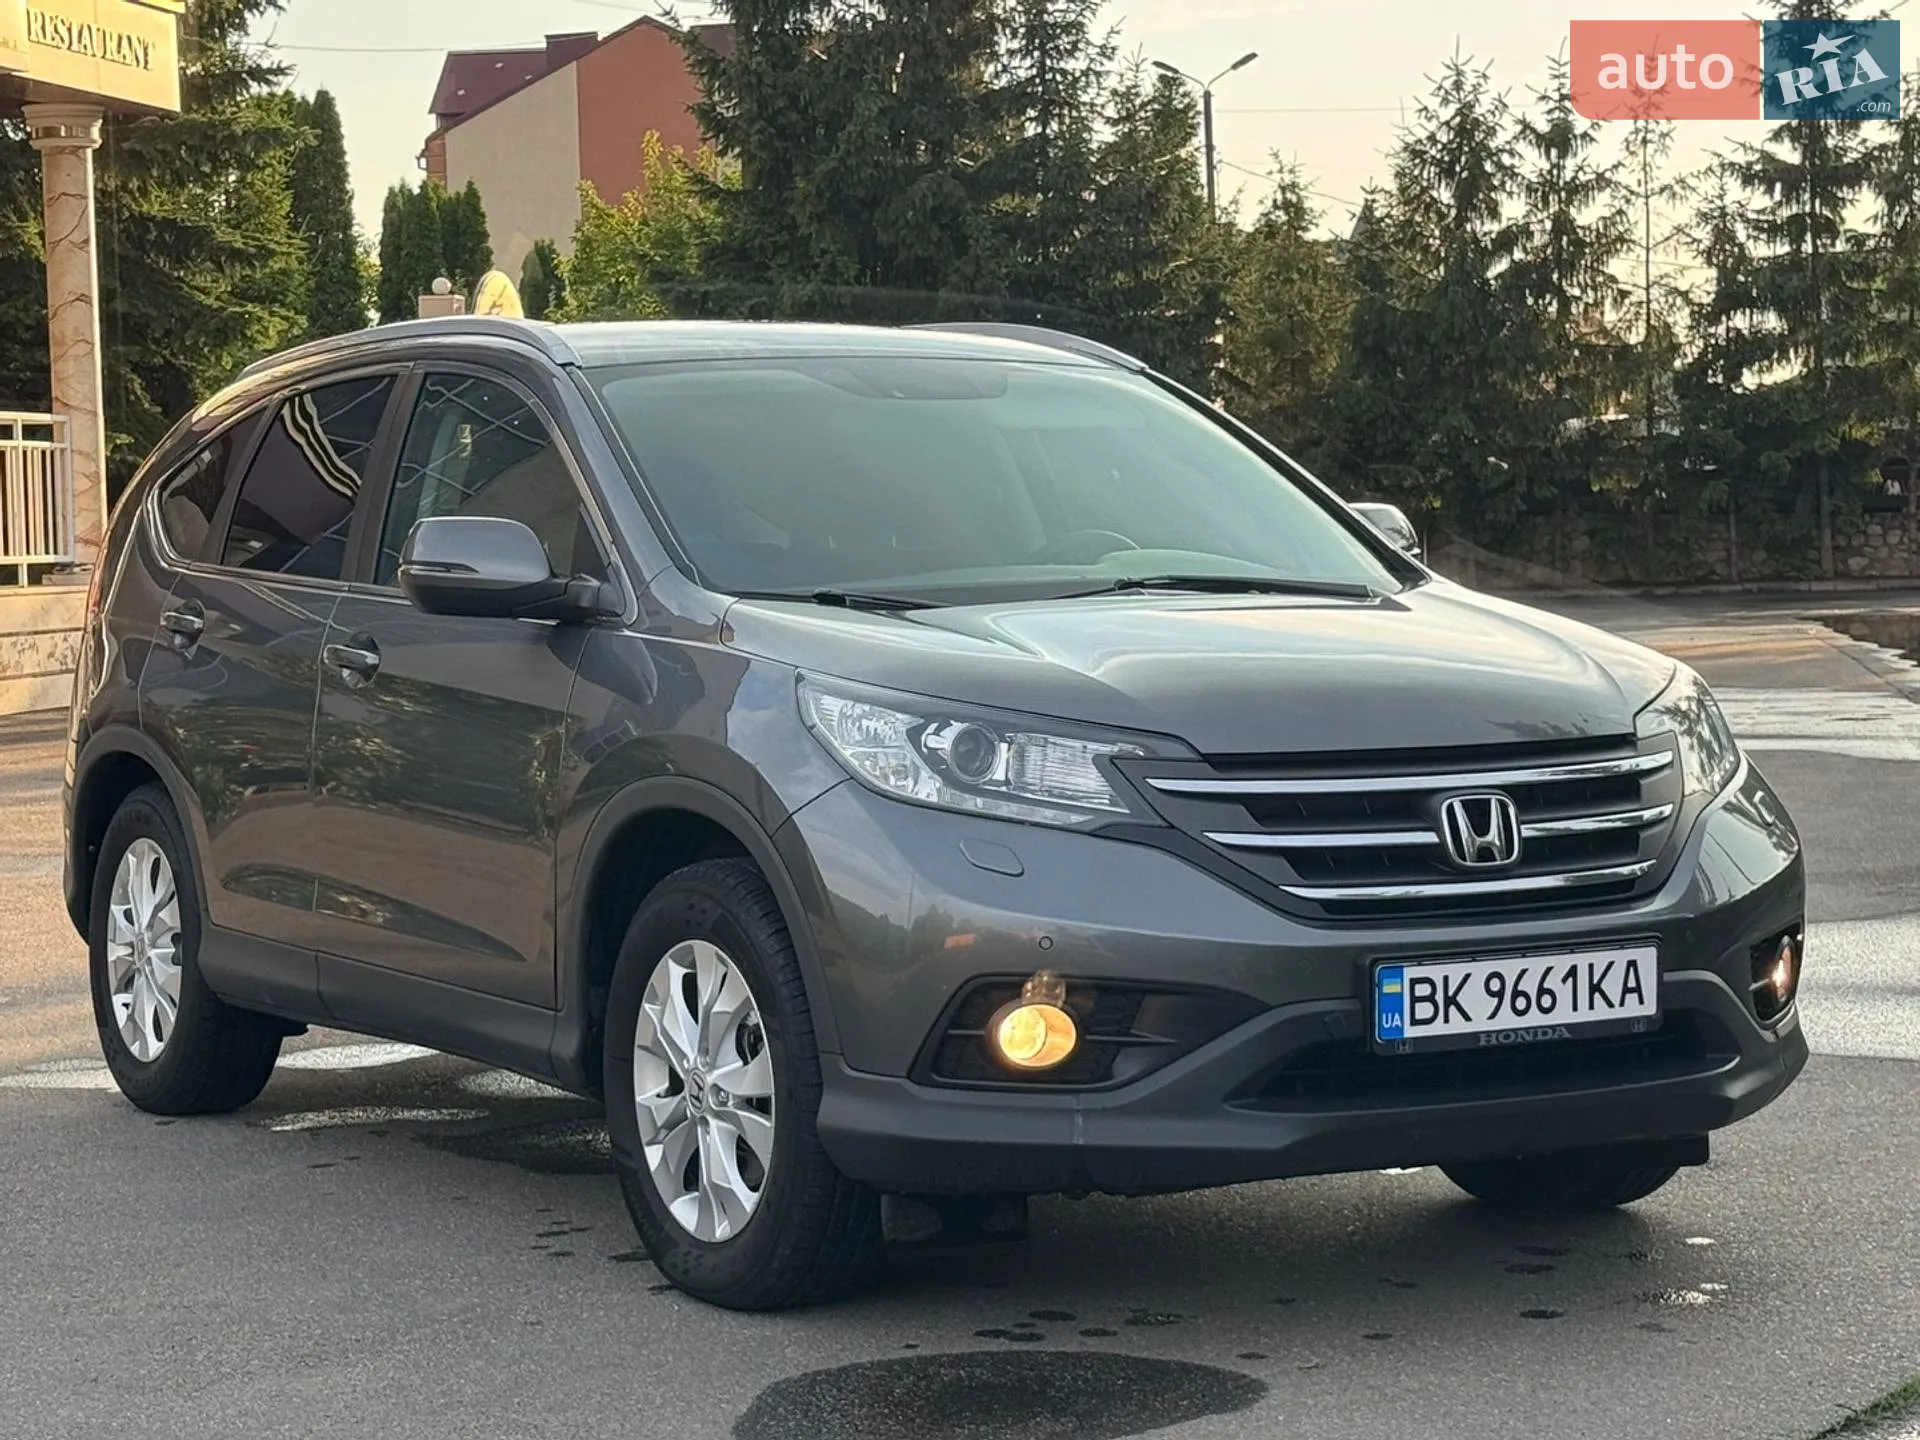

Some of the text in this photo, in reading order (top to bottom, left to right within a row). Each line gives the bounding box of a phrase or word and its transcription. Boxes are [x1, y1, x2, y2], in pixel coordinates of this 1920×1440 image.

[28, 10, 155, 70] RESTAURANT
[1382, 1012, 1402, 1028] UA
[1478, 1025, 1572, 1046] HONDA
